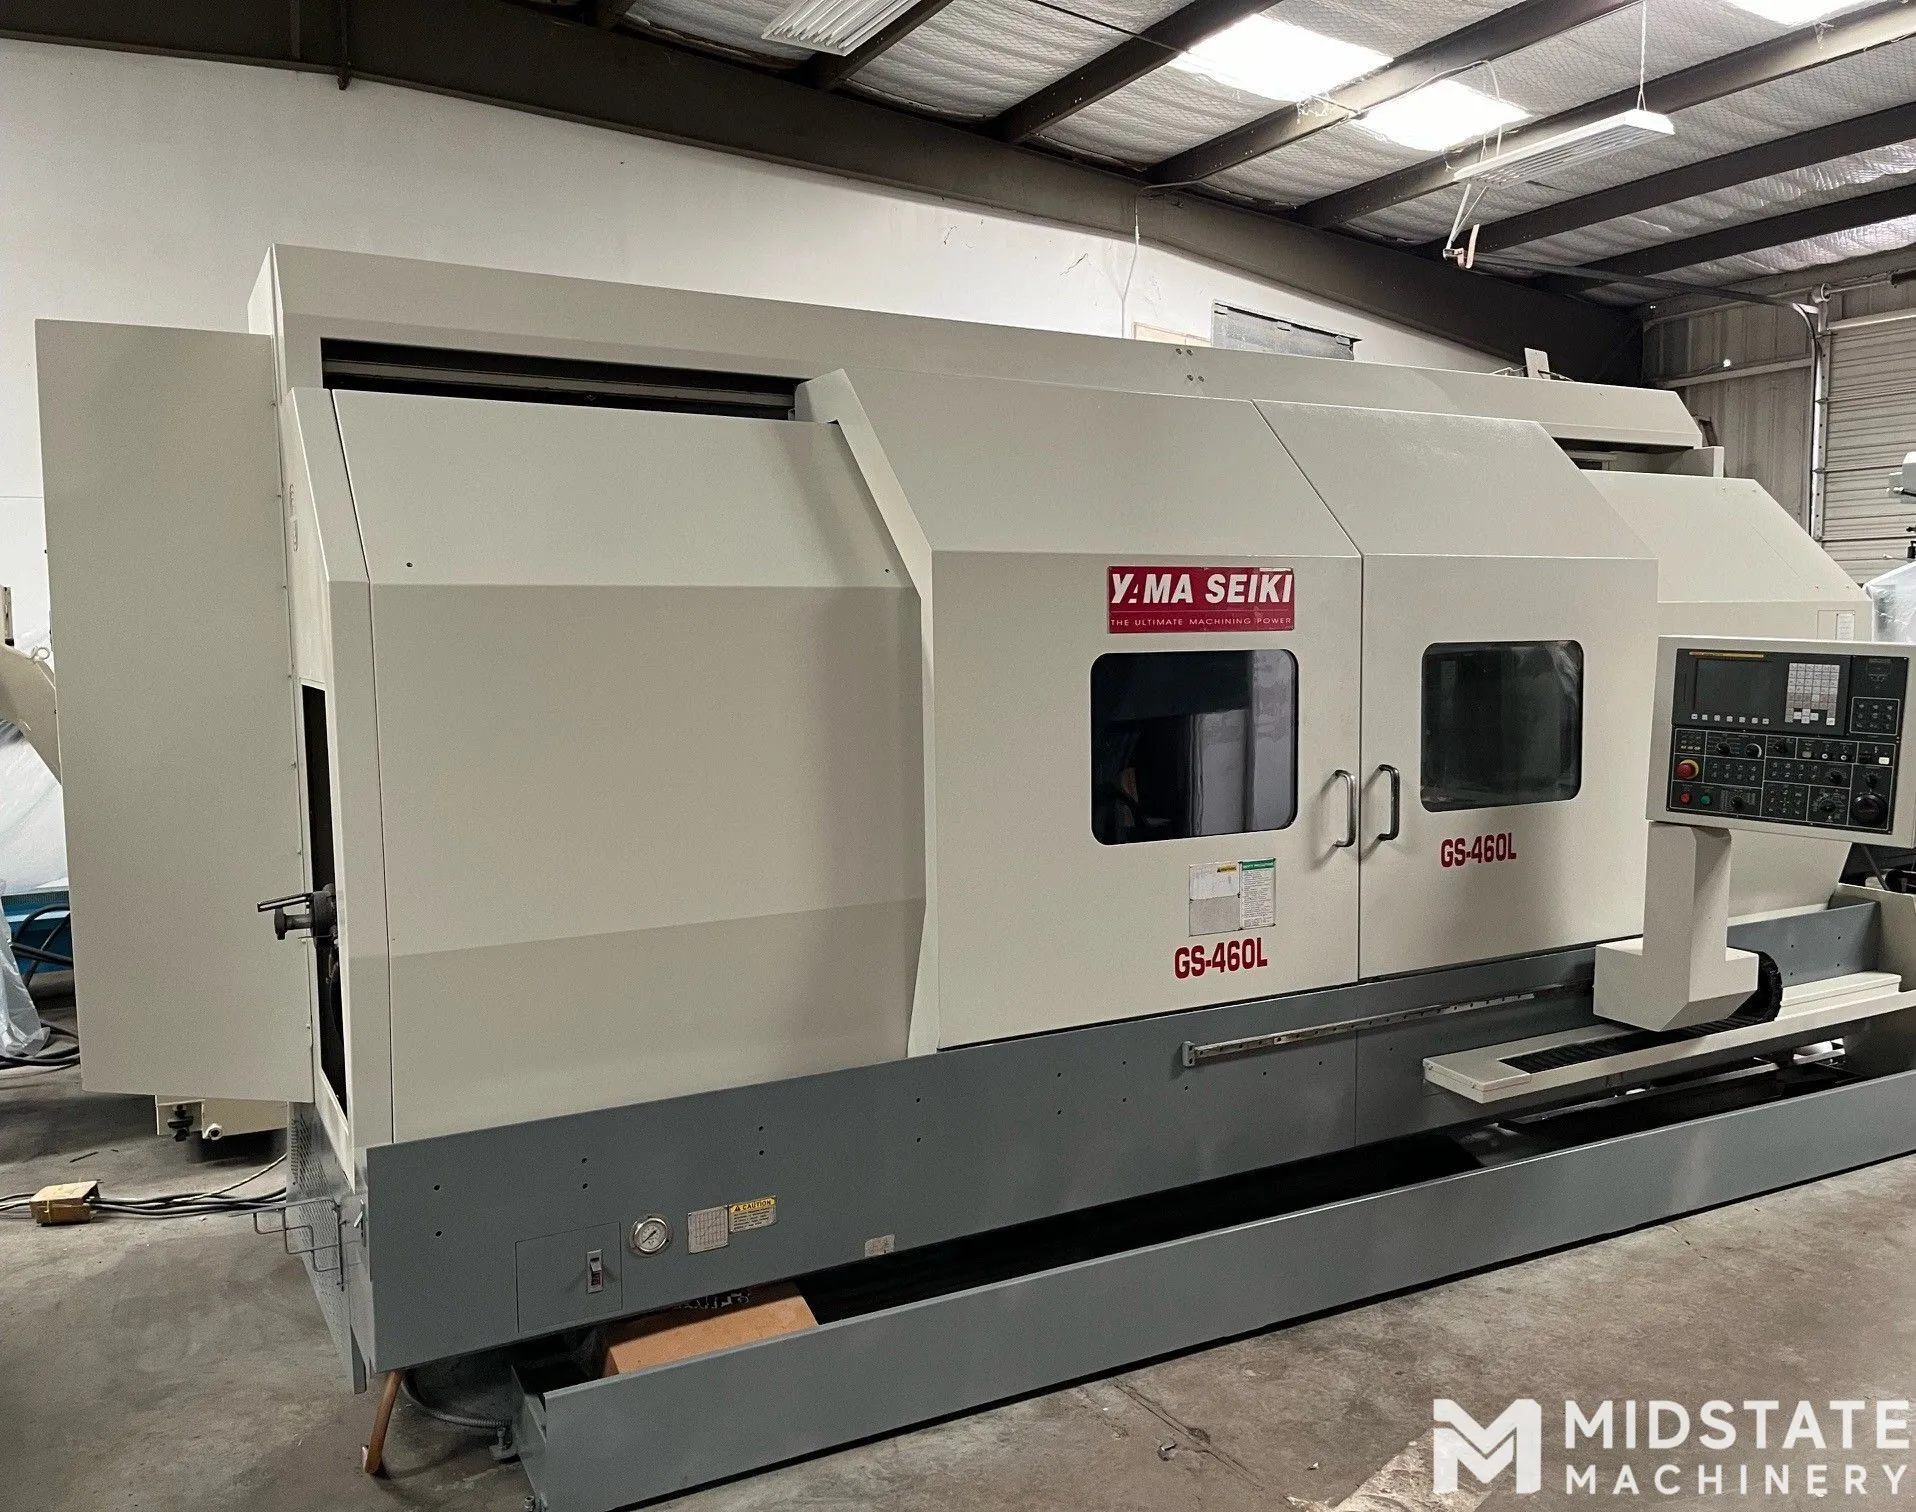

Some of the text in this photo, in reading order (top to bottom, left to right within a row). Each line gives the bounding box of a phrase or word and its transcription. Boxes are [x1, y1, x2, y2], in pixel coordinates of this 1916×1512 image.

[1205, 573, 1293, 604] SEIKI
[1110, 617, 1292, 627] THE ULTIMATE MACHINING POWER
[1440, 832, 1517, 868] GS-460L
[1174, 937, 1268, 980] GS-460L
[742, 1200, 771, 1211] CAUTION
